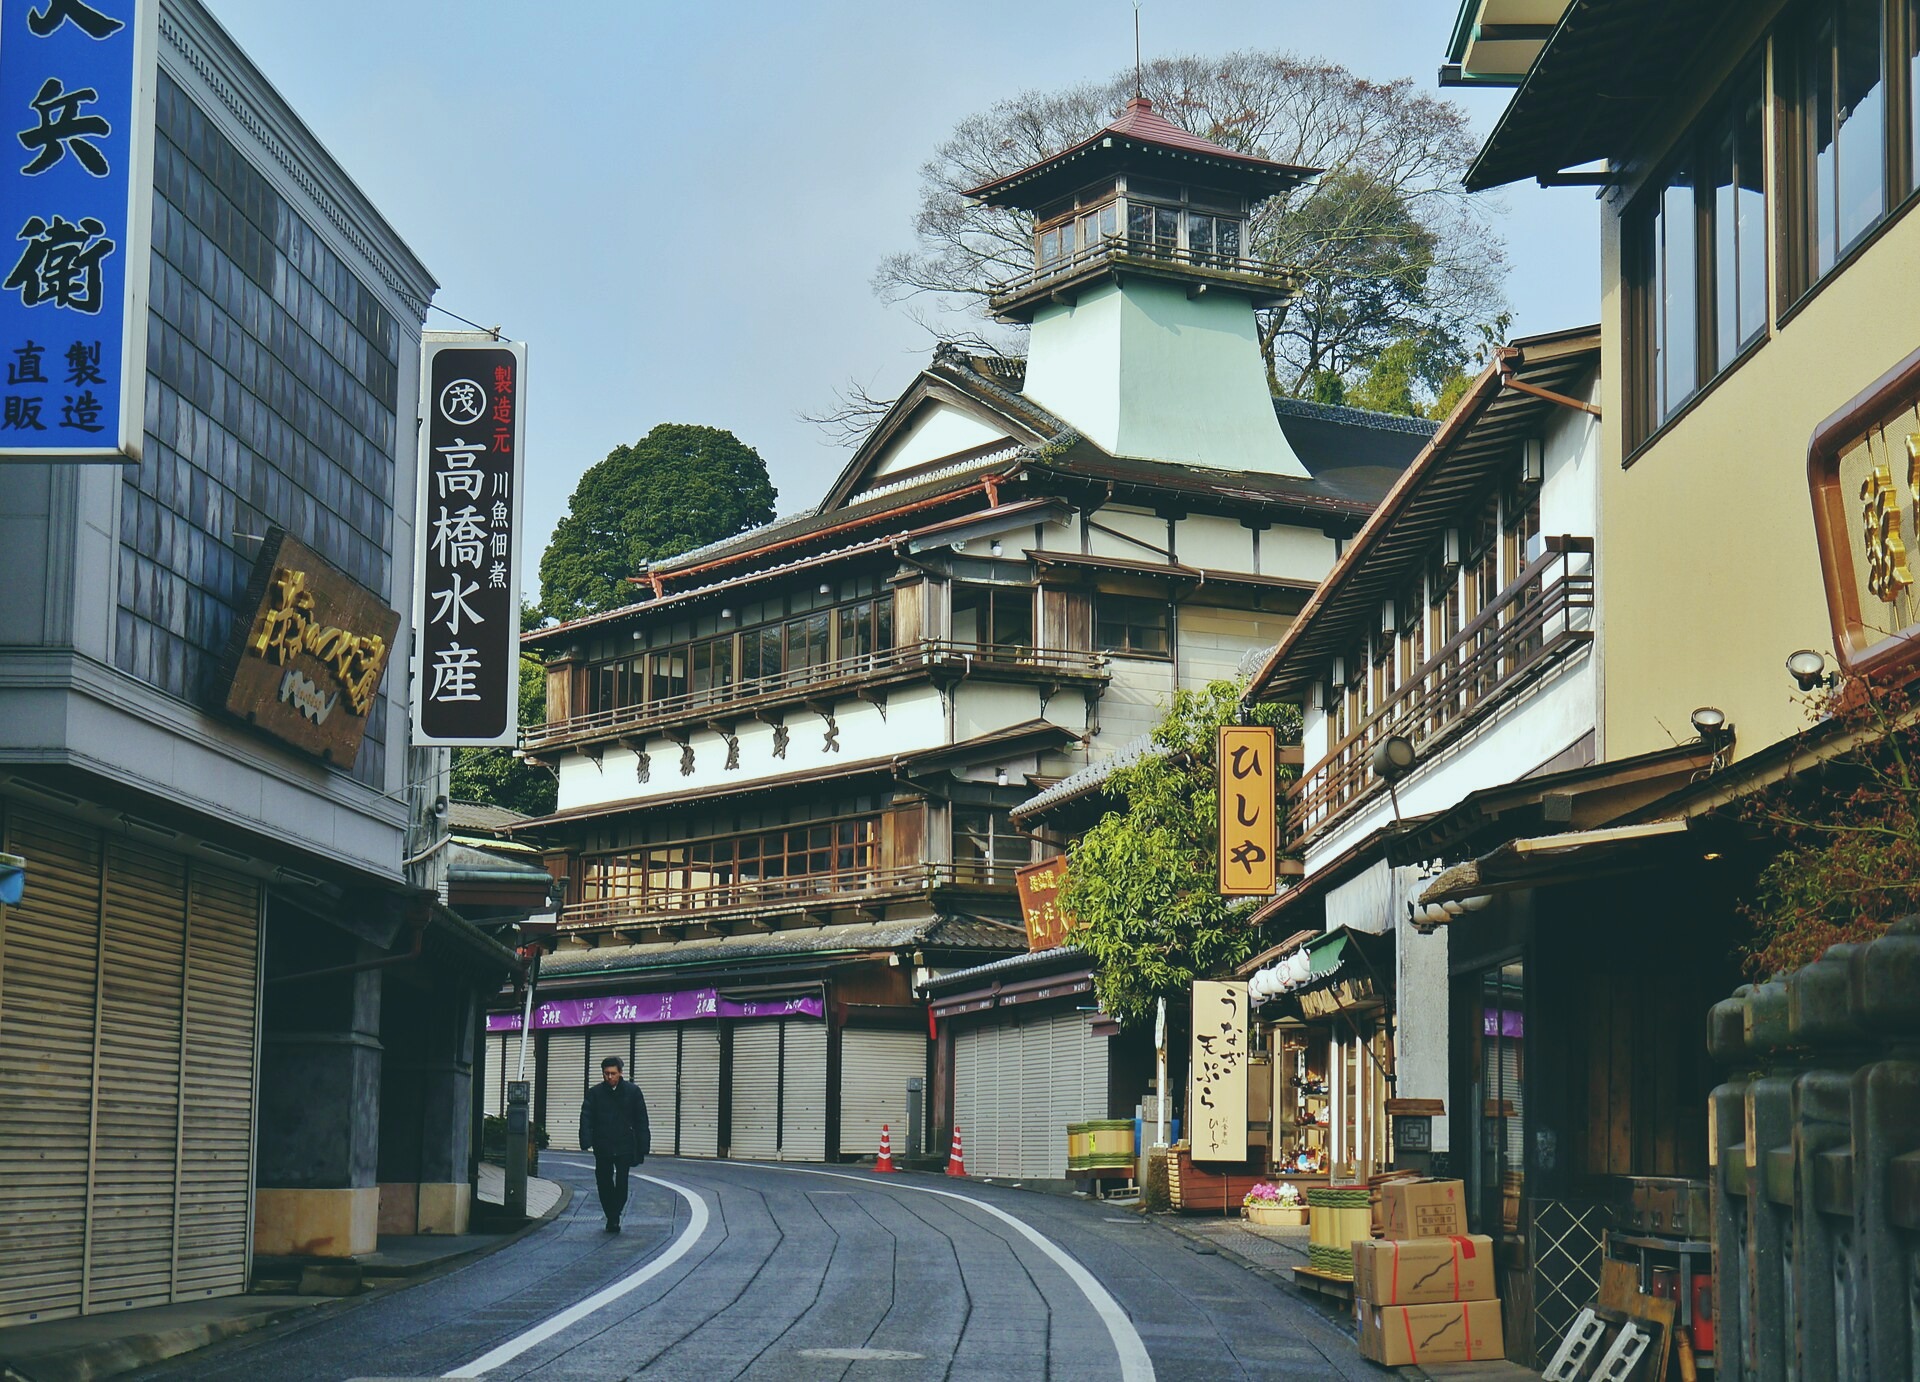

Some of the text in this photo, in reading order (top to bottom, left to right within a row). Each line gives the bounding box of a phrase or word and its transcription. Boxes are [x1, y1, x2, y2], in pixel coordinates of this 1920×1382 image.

[0, 340, 49, 431] 直販
[59, 340, 107, 433] 製造
[492, 365, 512, 454] 製造元
[429, 437, 488, 702] 高橋水産
[488, 471, 509, 590] 川魚佃煮
[1230, 745, 1267, 875] ひしや
[1196, 1034, 1219, 1110] 天ぷら
[1220, 988, 1245, 1075] うなぎ
[1208, 1118, 1219, 1155] ひしや
